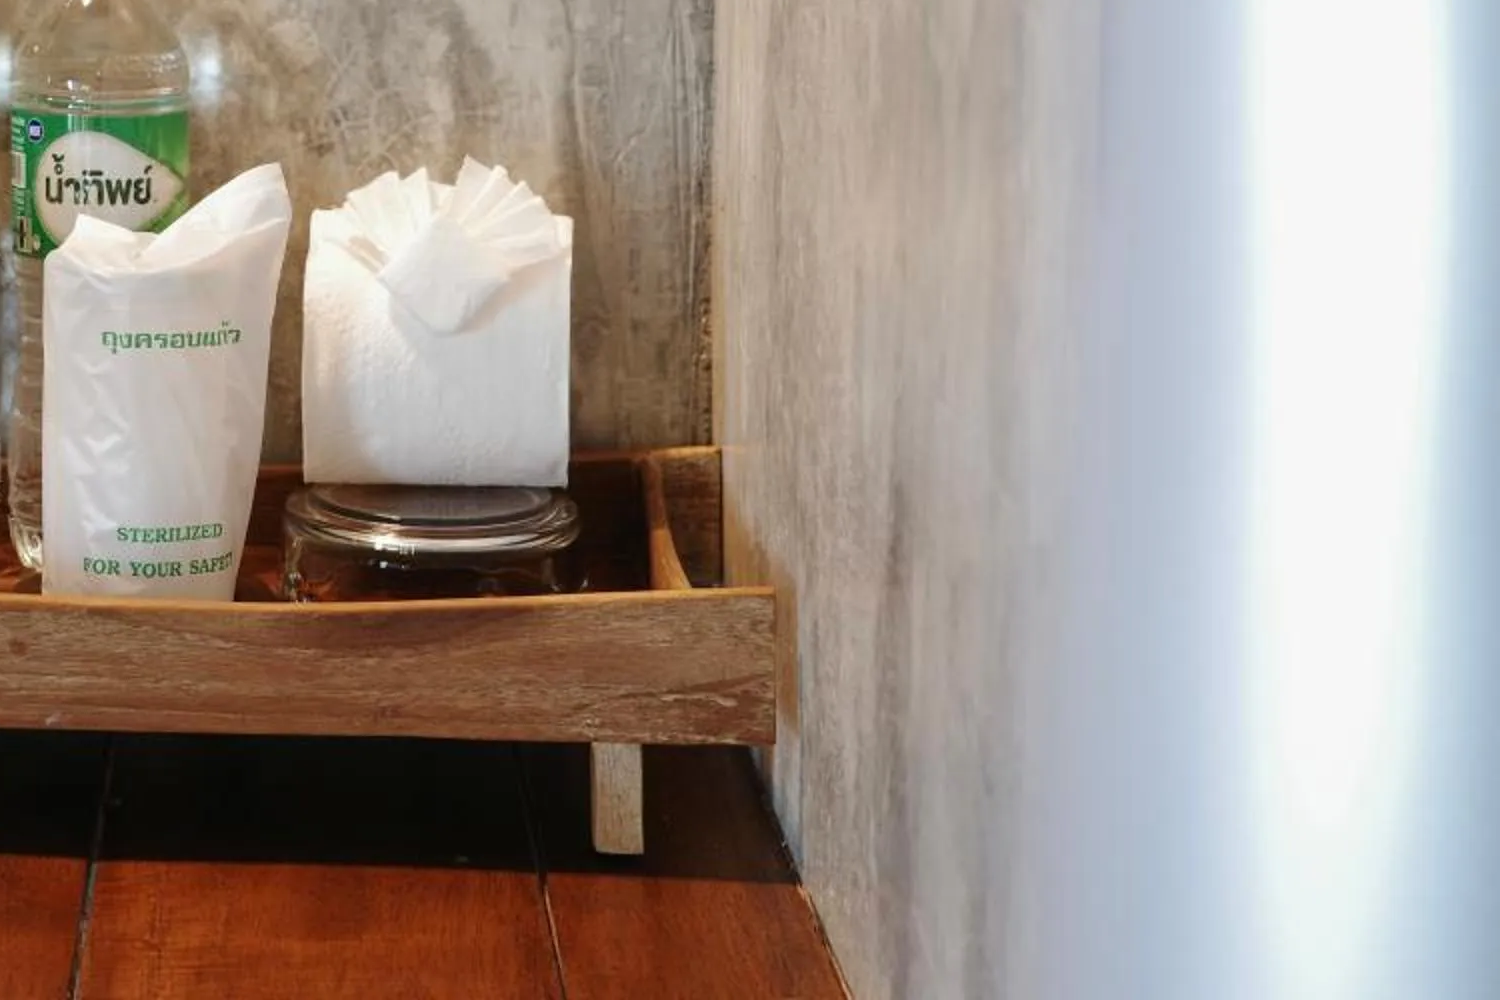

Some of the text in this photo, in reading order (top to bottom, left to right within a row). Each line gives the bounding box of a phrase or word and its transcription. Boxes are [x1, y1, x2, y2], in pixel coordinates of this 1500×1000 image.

[45, 153, 153, 206] น้ำทิพย์
[116, 523, 223, 543] STERILIZED
[83, 557, 120, 575] FOR
[130, 561, 182, 578] YOUR
